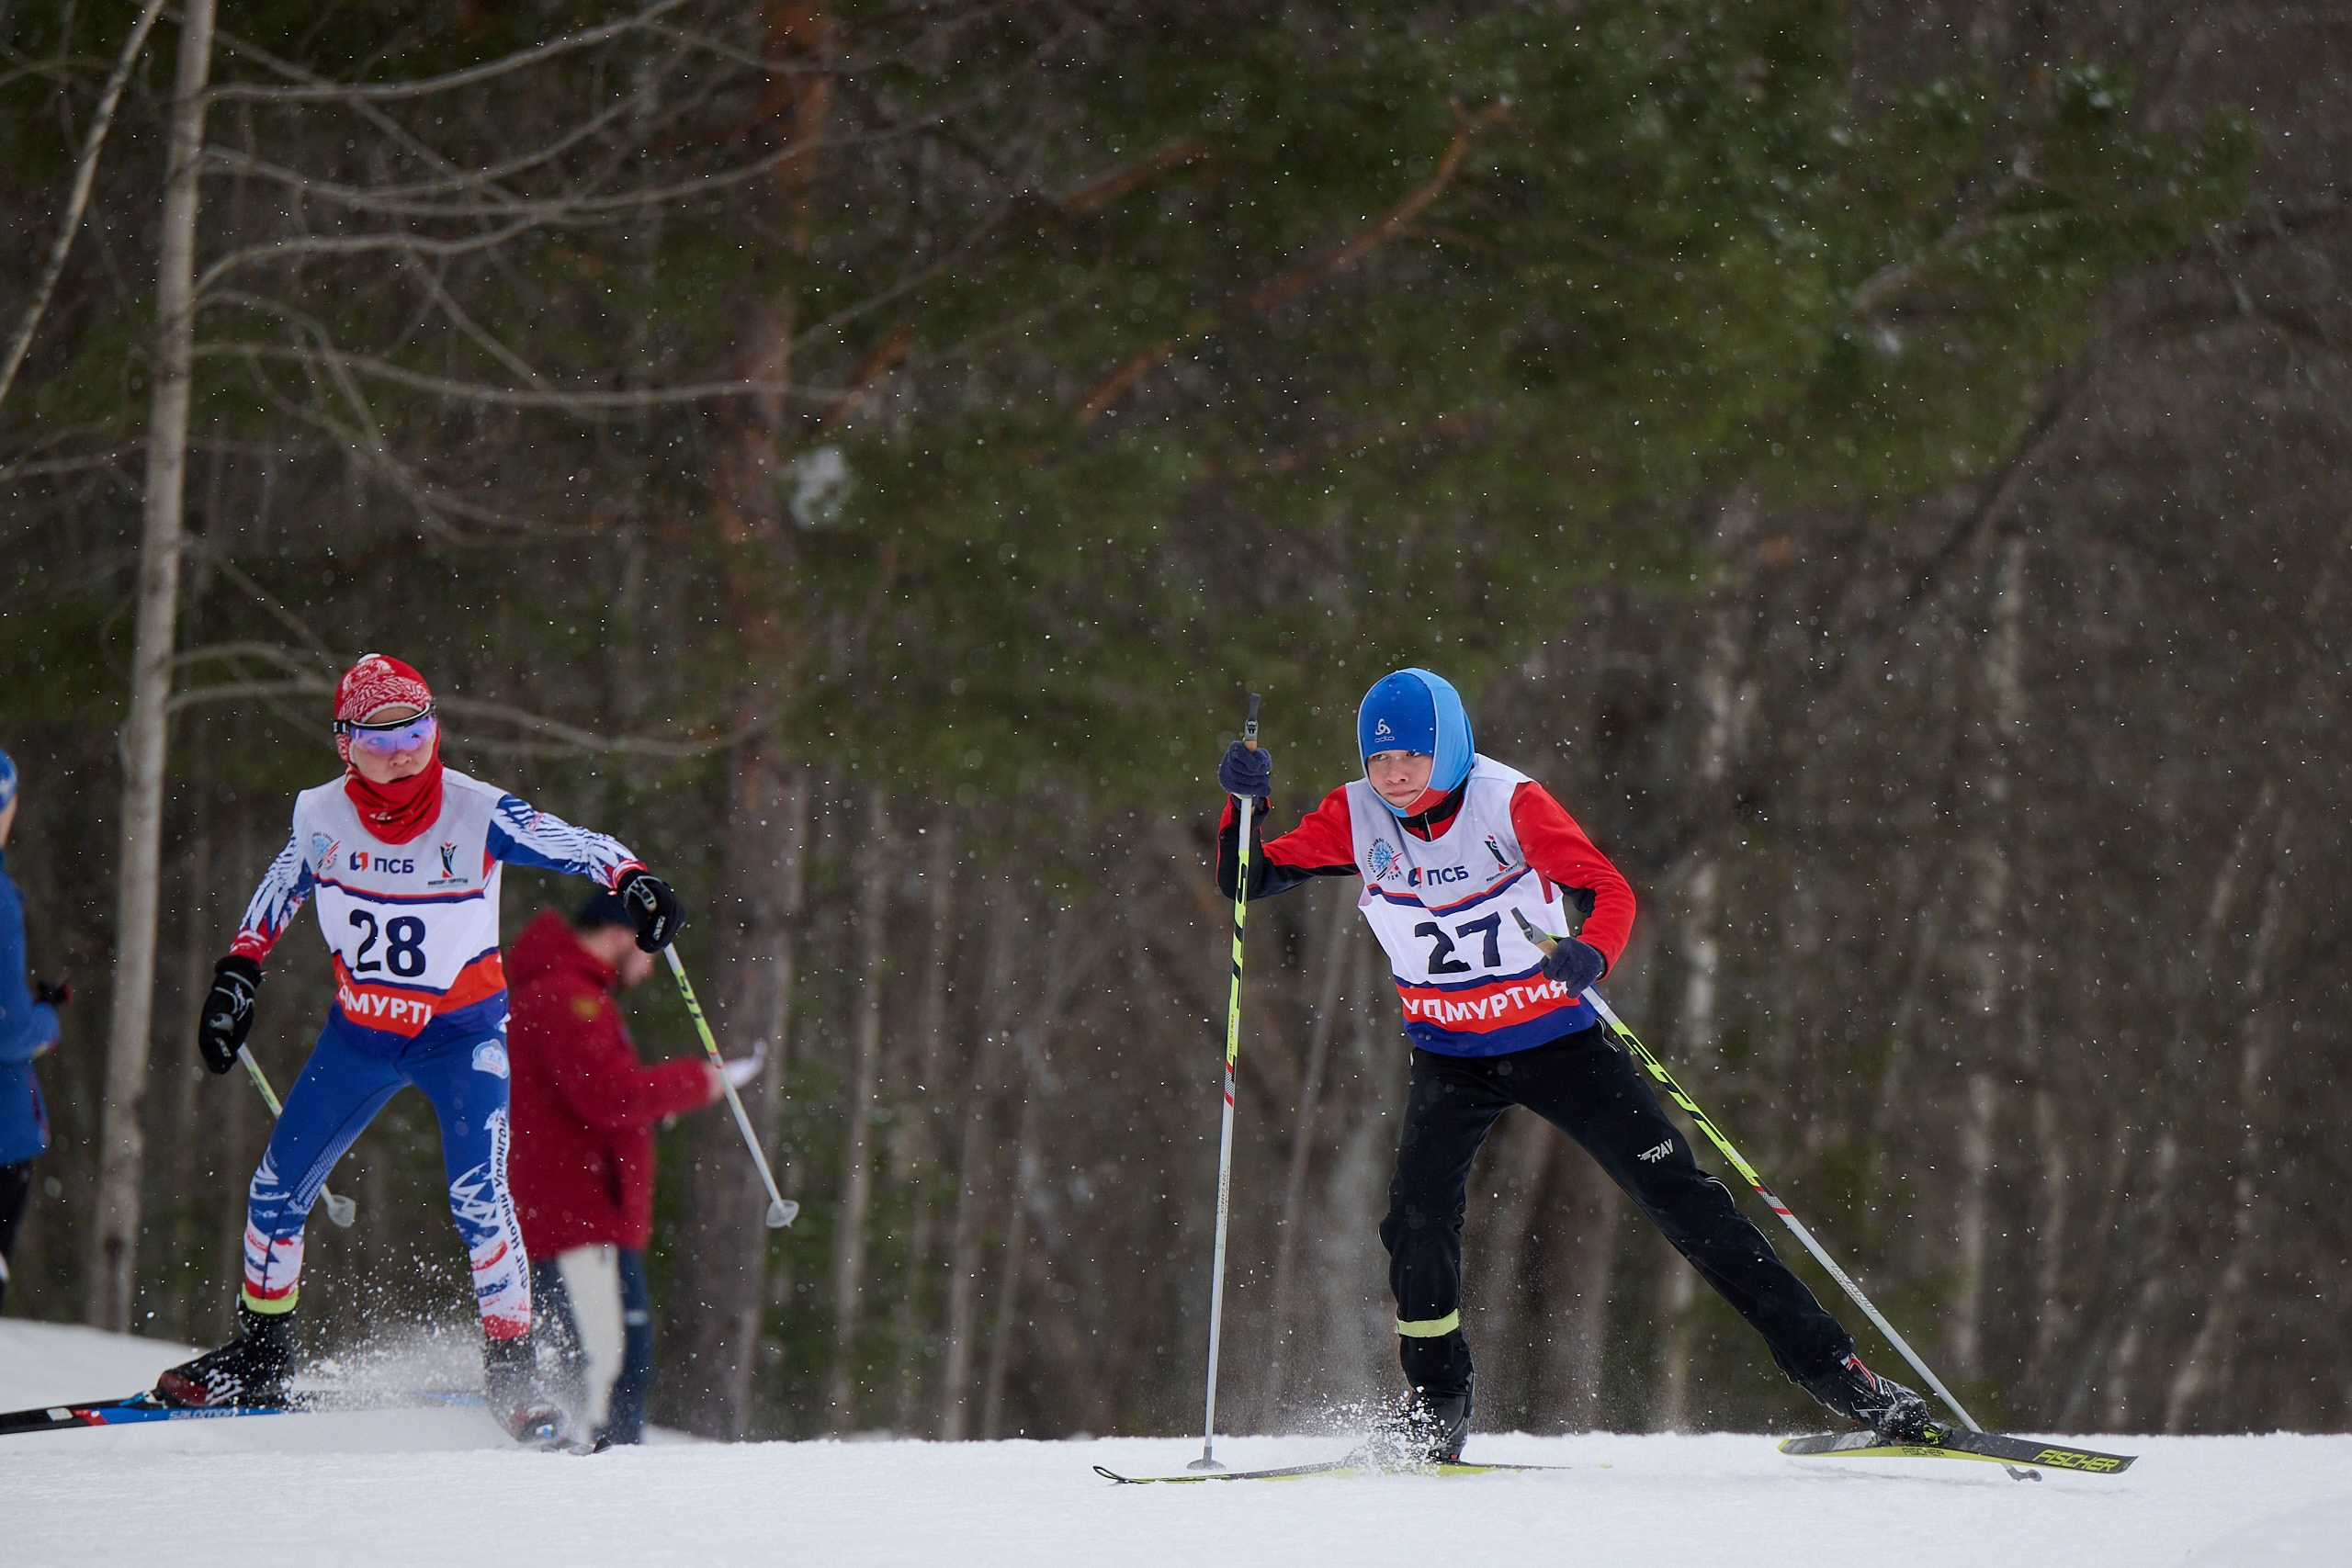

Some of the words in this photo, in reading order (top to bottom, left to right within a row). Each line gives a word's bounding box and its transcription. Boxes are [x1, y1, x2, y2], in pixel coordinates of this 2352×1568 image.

[374, 858, 414, 874] ПСБ
[1427, 865, 1469, 886] ПСБ
[349, 909, 425, 977] 28
[1415, 911, 1501, 975] 27
[1401, 980, 1568, 1024] УДМУРТИЯ
[494, 1115, 507, 1188] Уренгой
[1640, 1138, 1674, 1164] RAY
[498, 1192, 520, 1250] Новый
[1902, 1447, 1946, 1458] FISCHER
[2032, 1449, 2120, 1472] FISCHER
